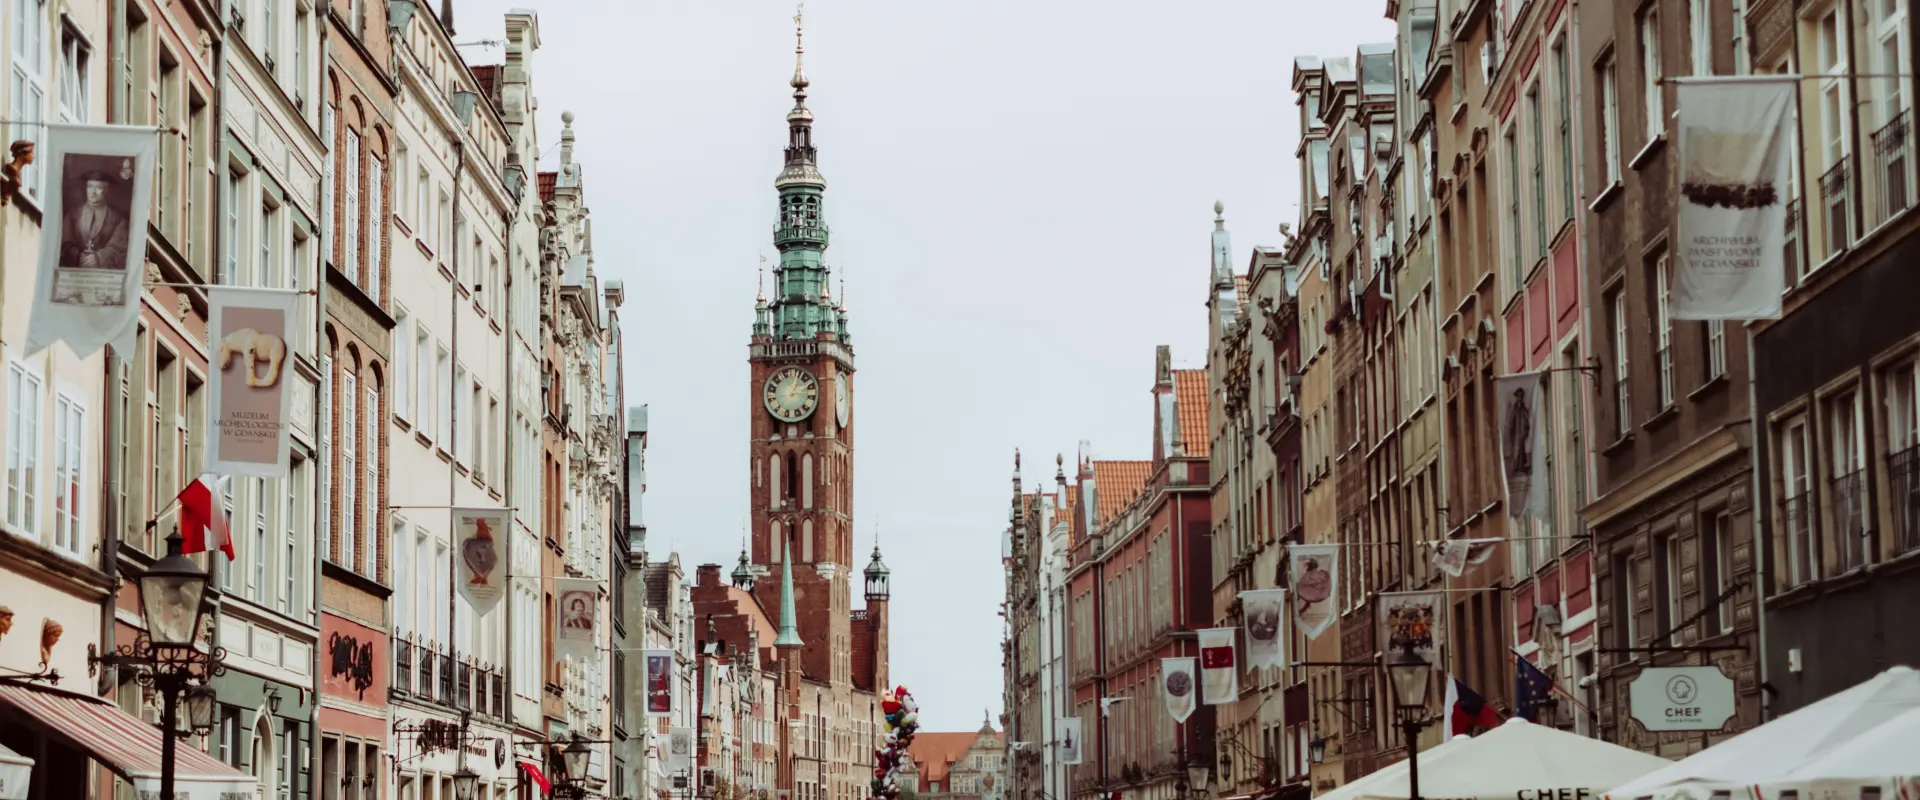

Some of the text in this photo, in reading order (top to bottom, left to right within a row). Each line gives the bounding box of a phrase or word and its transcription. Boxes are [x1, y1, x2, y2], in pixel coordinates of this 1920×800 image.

[1689, 259, 1701, 269] W
[231, 411, 270, 420] MUZEUM
[223, 428, 233, 437] W
[1665, 707, 1701, 717] CHEF
[1517, 787, 1590, 800] CHEF
